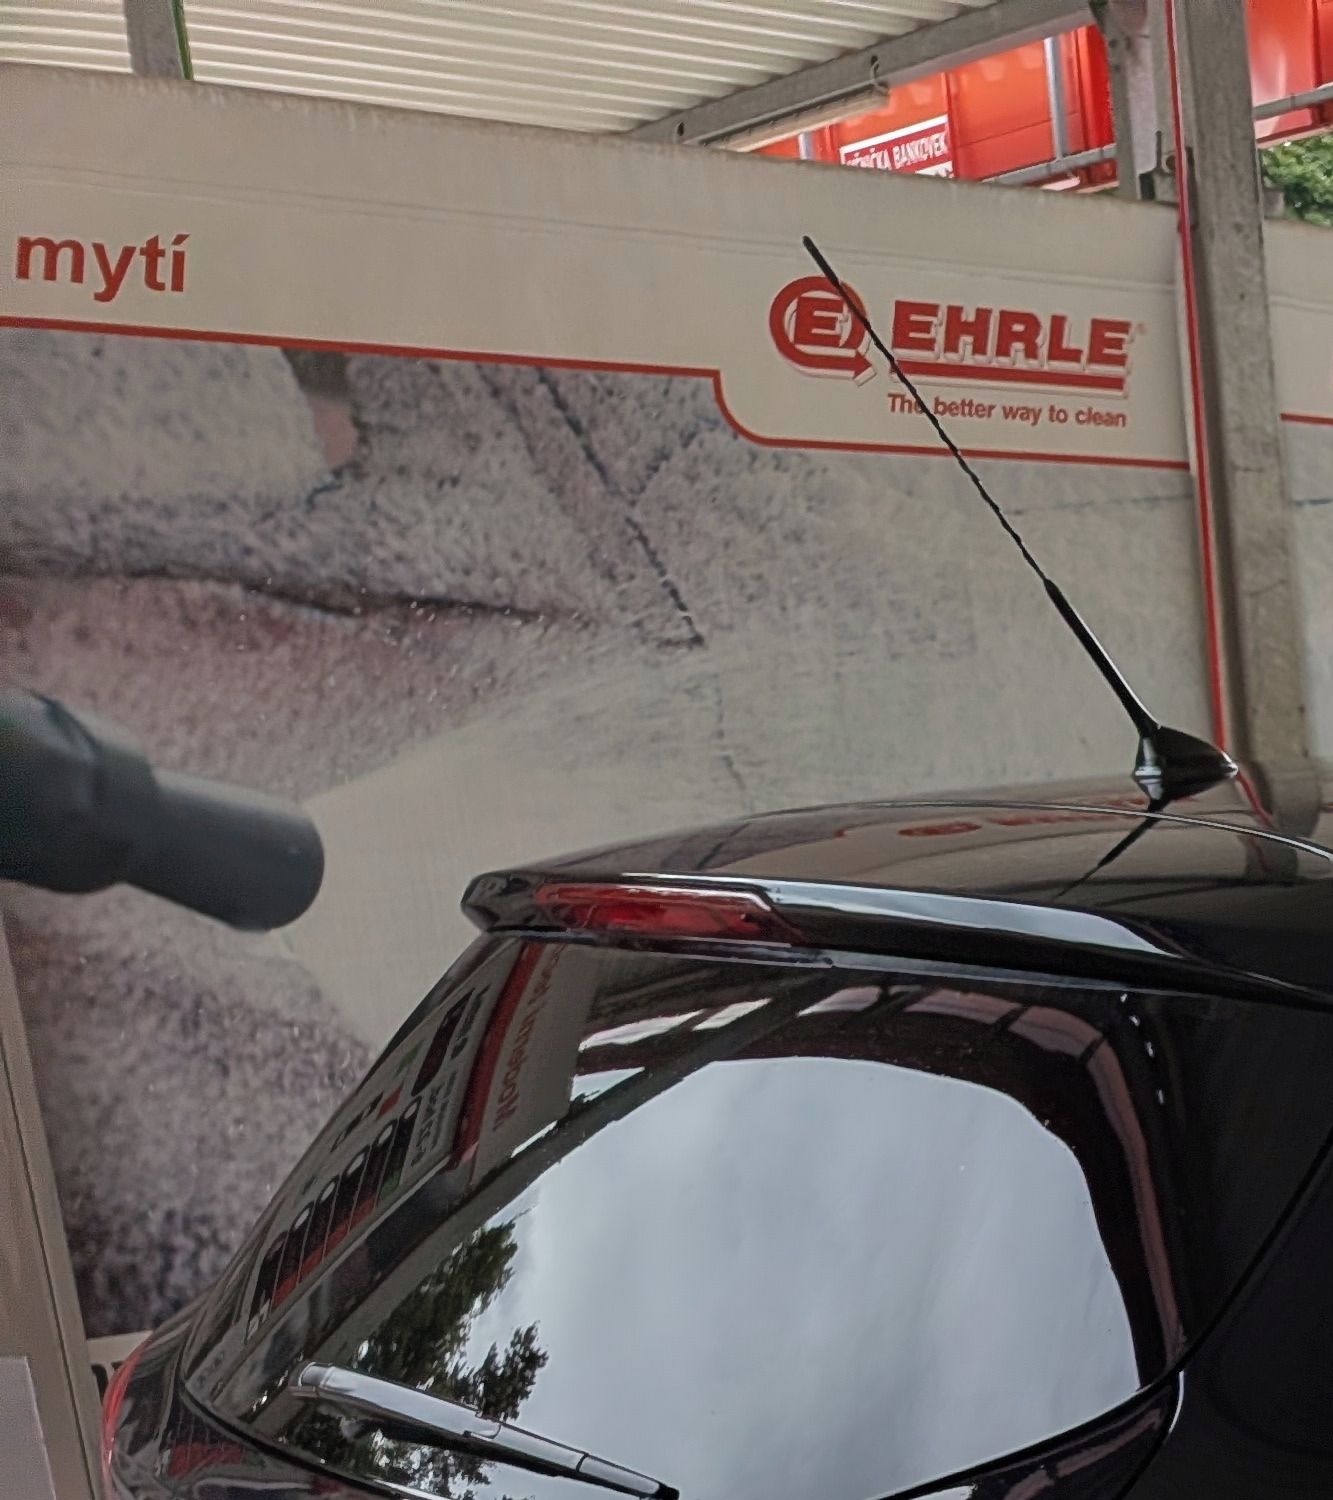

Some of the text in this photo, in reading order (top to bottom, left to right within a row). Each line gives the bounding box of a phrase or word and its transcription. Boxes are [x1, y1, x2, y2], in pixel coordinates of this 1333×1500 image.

[15, 233, 192, 303] mytí
[891, 299, 1133, 370] EHRLE
[932, 396, 997, 420] better
[1001, 405, 1043, 427] way
[1047, 404, 1068, 424] to
[1073, 406, 1127, 428] clean
